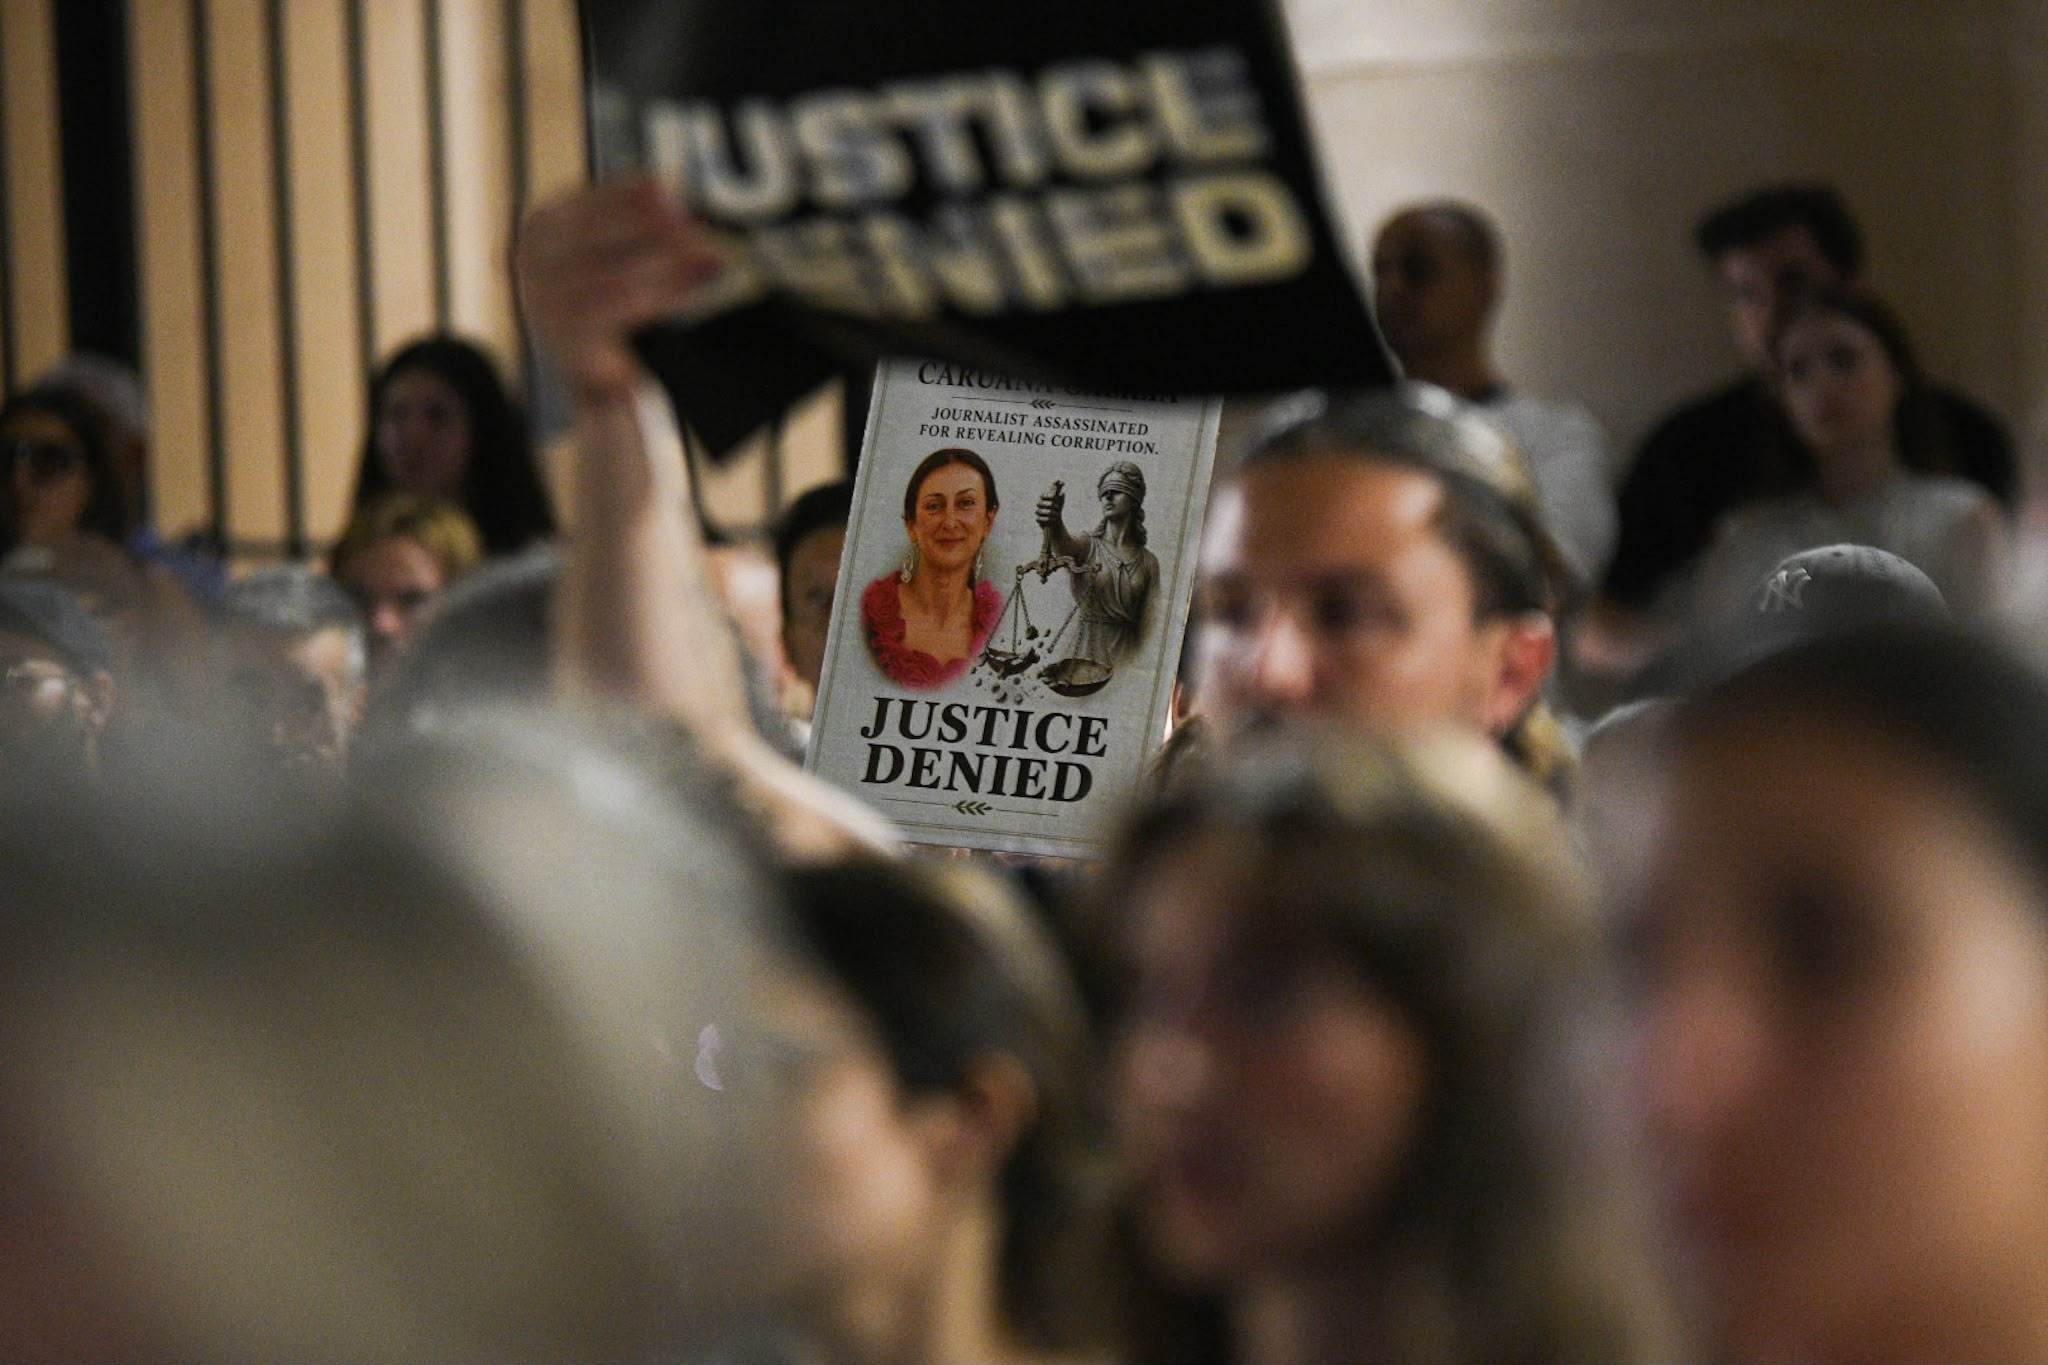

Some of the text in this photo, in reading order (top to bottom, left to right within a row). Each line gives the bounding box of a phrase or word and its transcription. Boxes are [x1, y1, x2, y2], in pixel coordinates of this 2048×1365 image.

[919, 424, 1159, 455] FOR REVEALING CORRUPTION.
[931, 407, 1149, 436] JOURNALIST ASSASSINATED
[860, 696, 1109, 758] JUSTICE
[861, 743, 1093, 802] DENIED
